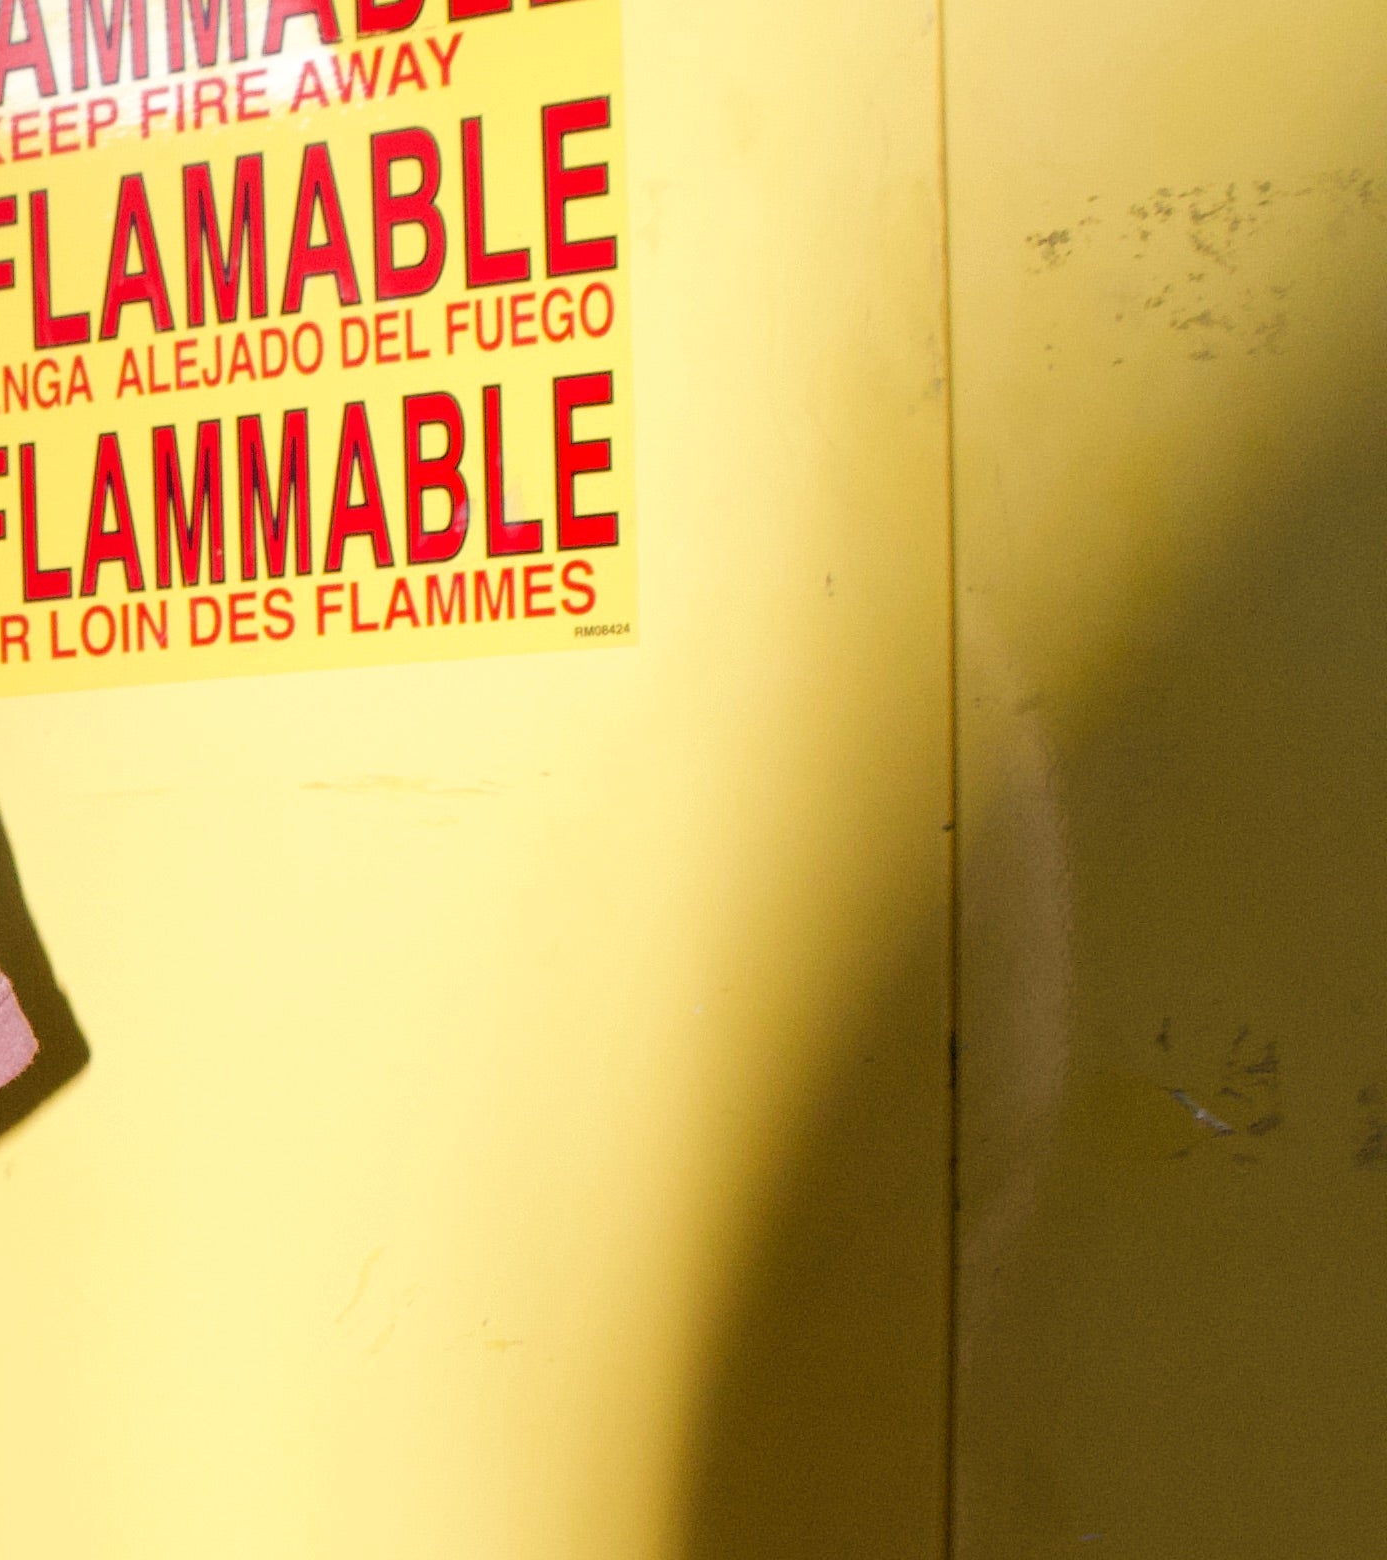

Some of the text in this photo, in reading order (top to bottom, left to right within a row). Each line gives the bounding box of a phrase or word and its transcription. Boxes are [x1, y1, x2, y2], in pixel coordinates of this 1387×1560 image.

[141, 70, 270, 140] FIRE
[290, 32, 464, 114] AWAY
[115, 320, 325, 399] ALEJADO
[340, 309, 431, 370] DEL
[445, 281, 616, 355] FUEGO
[49, 599, 170, 660] LOIN
[188, 587, 296, 648] DES
[315, 558, 597, 636] FLAMMES
